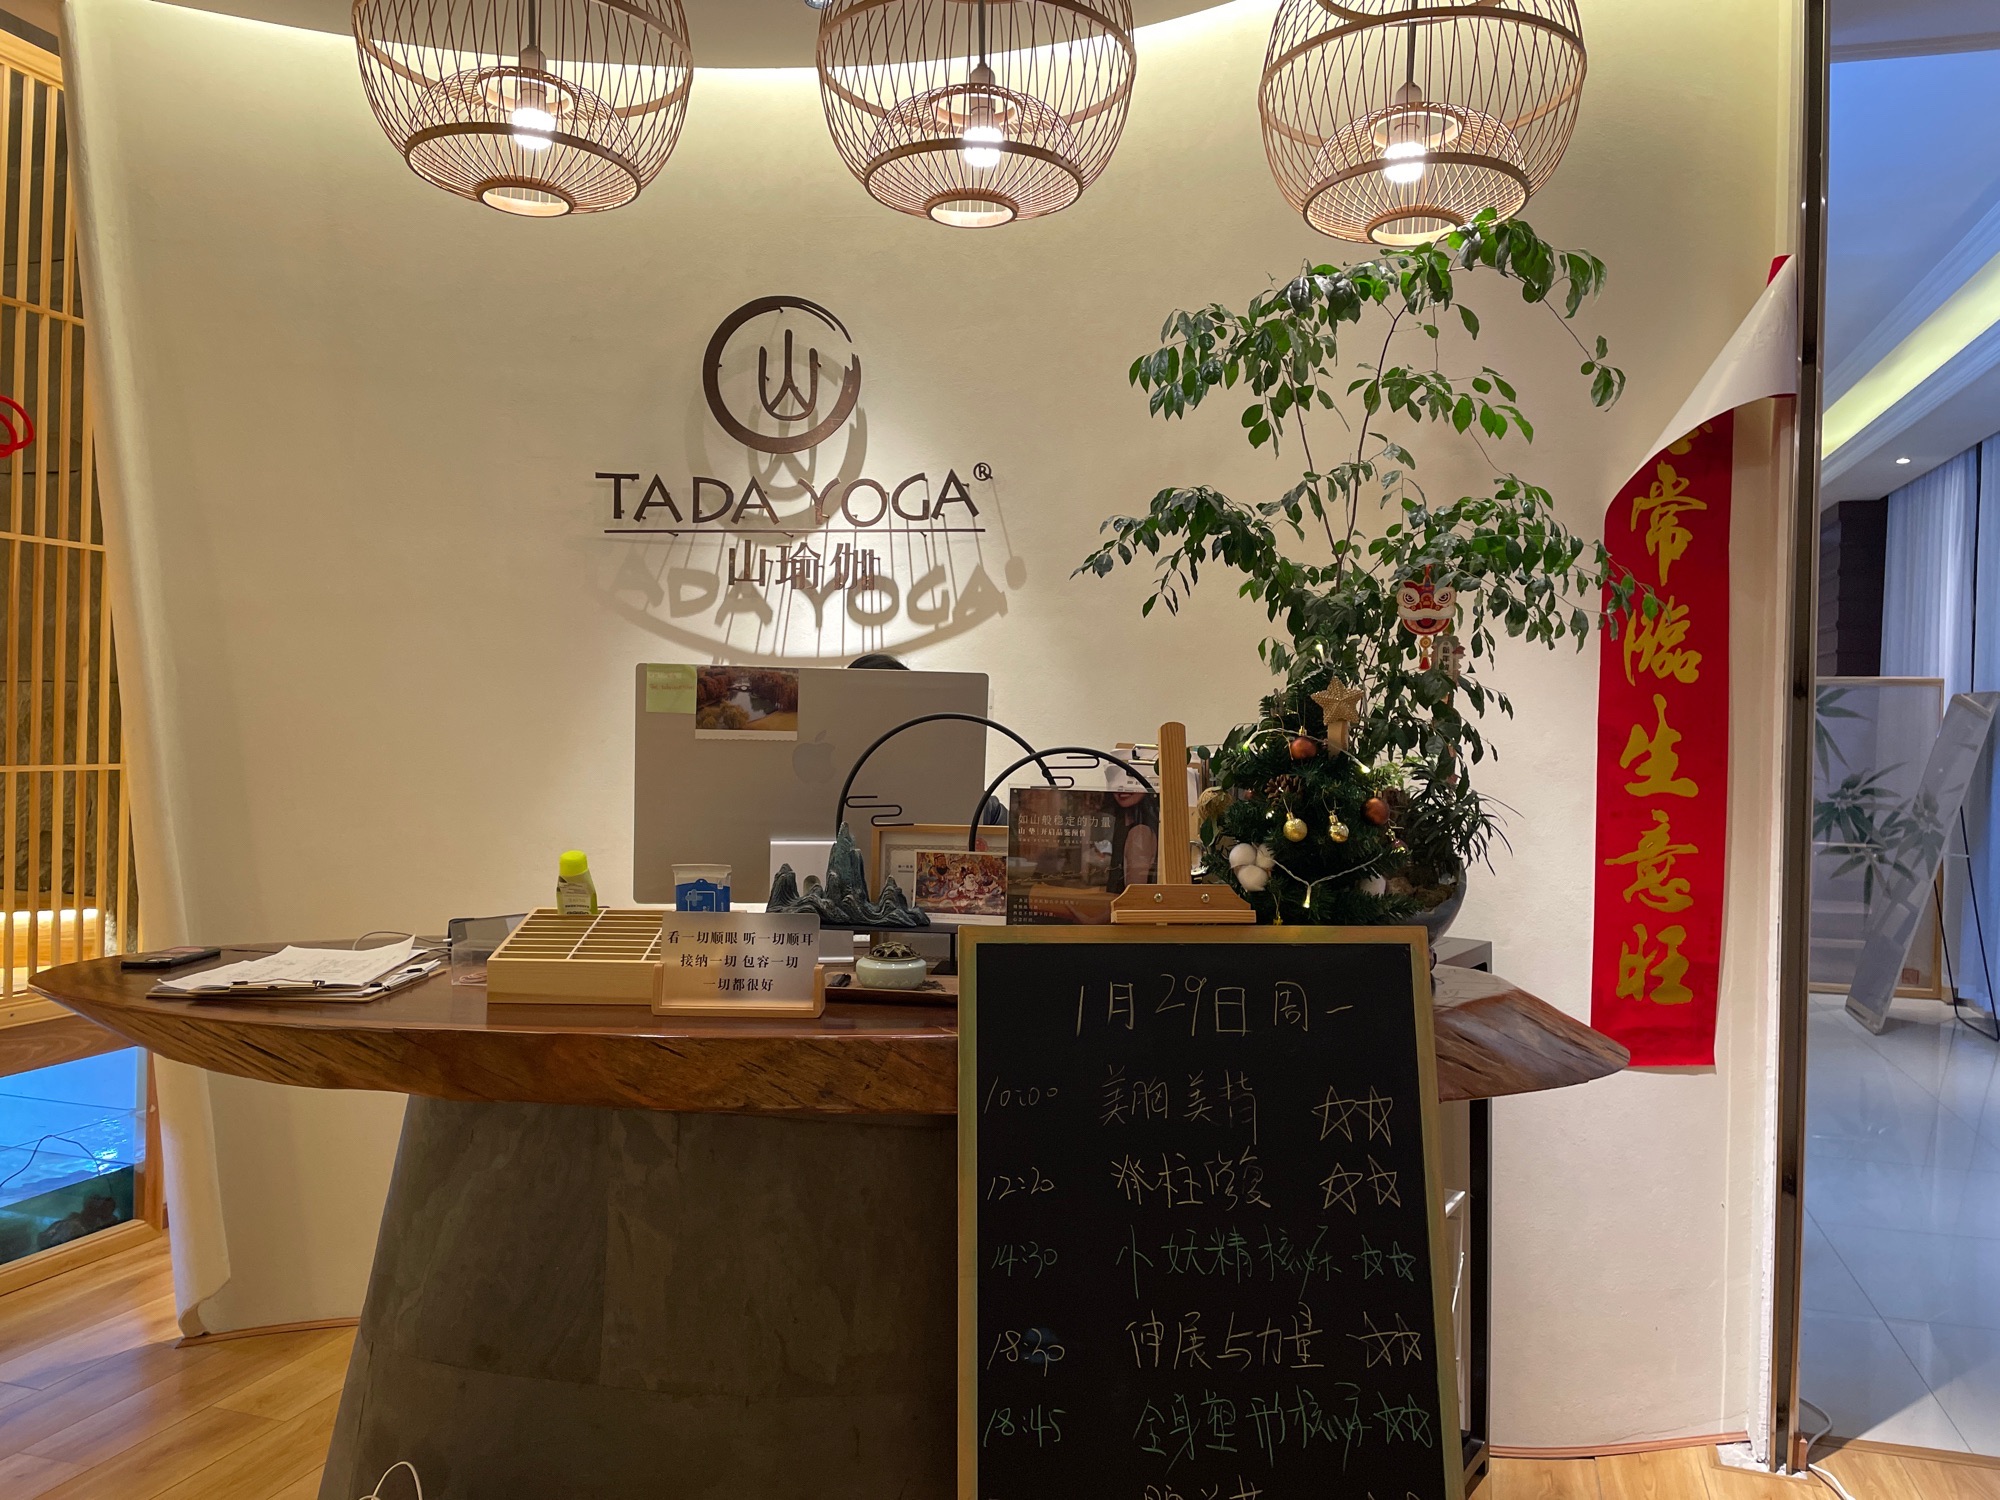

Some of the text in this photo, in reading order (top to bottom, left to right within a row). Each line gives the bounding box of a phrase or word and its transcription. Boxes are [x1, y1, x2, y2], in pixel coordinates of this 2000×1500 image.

[595, 471, 780, 526] TADA
[798, 469, 980, 528] YOGA
[728, 539, 881, 591] 山瑜伽
[1018, 814, 1111, 828] 如山般稳定的力量
[667, 931, 814, 946] 看一切顺眼 听一切顺耳
[680, 953, 799, 969] 接纳一切 包容一切
[703, 977, 774, 992] 一切都很好
[1076, 973, 1354, 1037] 1月29日 周一
[991, 1241, 1058, 1278] 14:30
[1125, 1302, 1325, 1370] 伸展与力量
[983, 1403, 1067, 1448] 18:45
